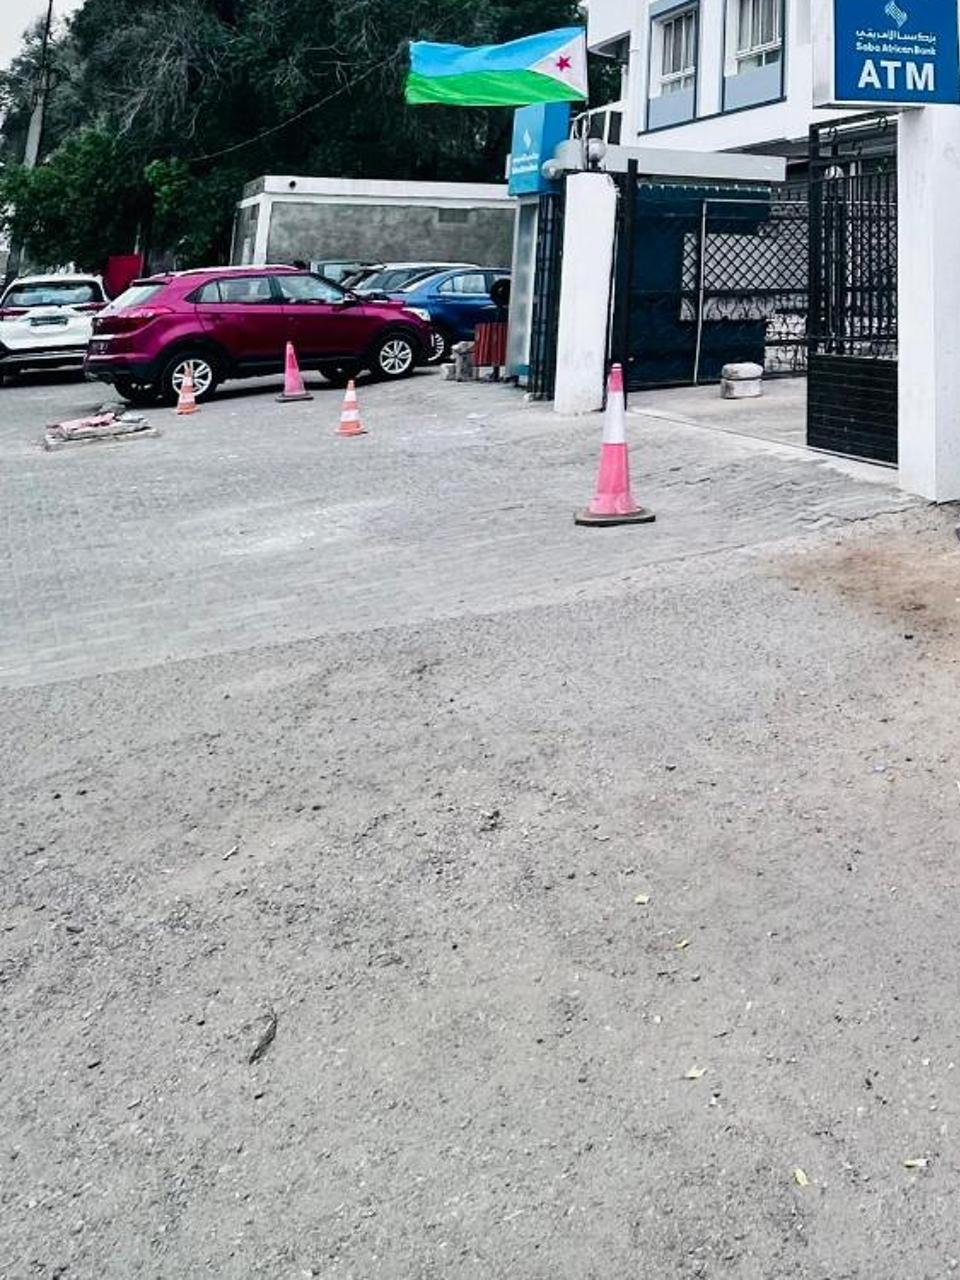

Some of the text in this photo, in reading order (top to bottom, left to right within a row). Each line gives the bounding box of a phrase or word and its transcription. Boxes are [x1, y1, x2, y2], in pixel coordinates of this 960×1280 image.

[856, 42, 937, 56] Saba African Bank
[858, 59, 935, 91] ATM
